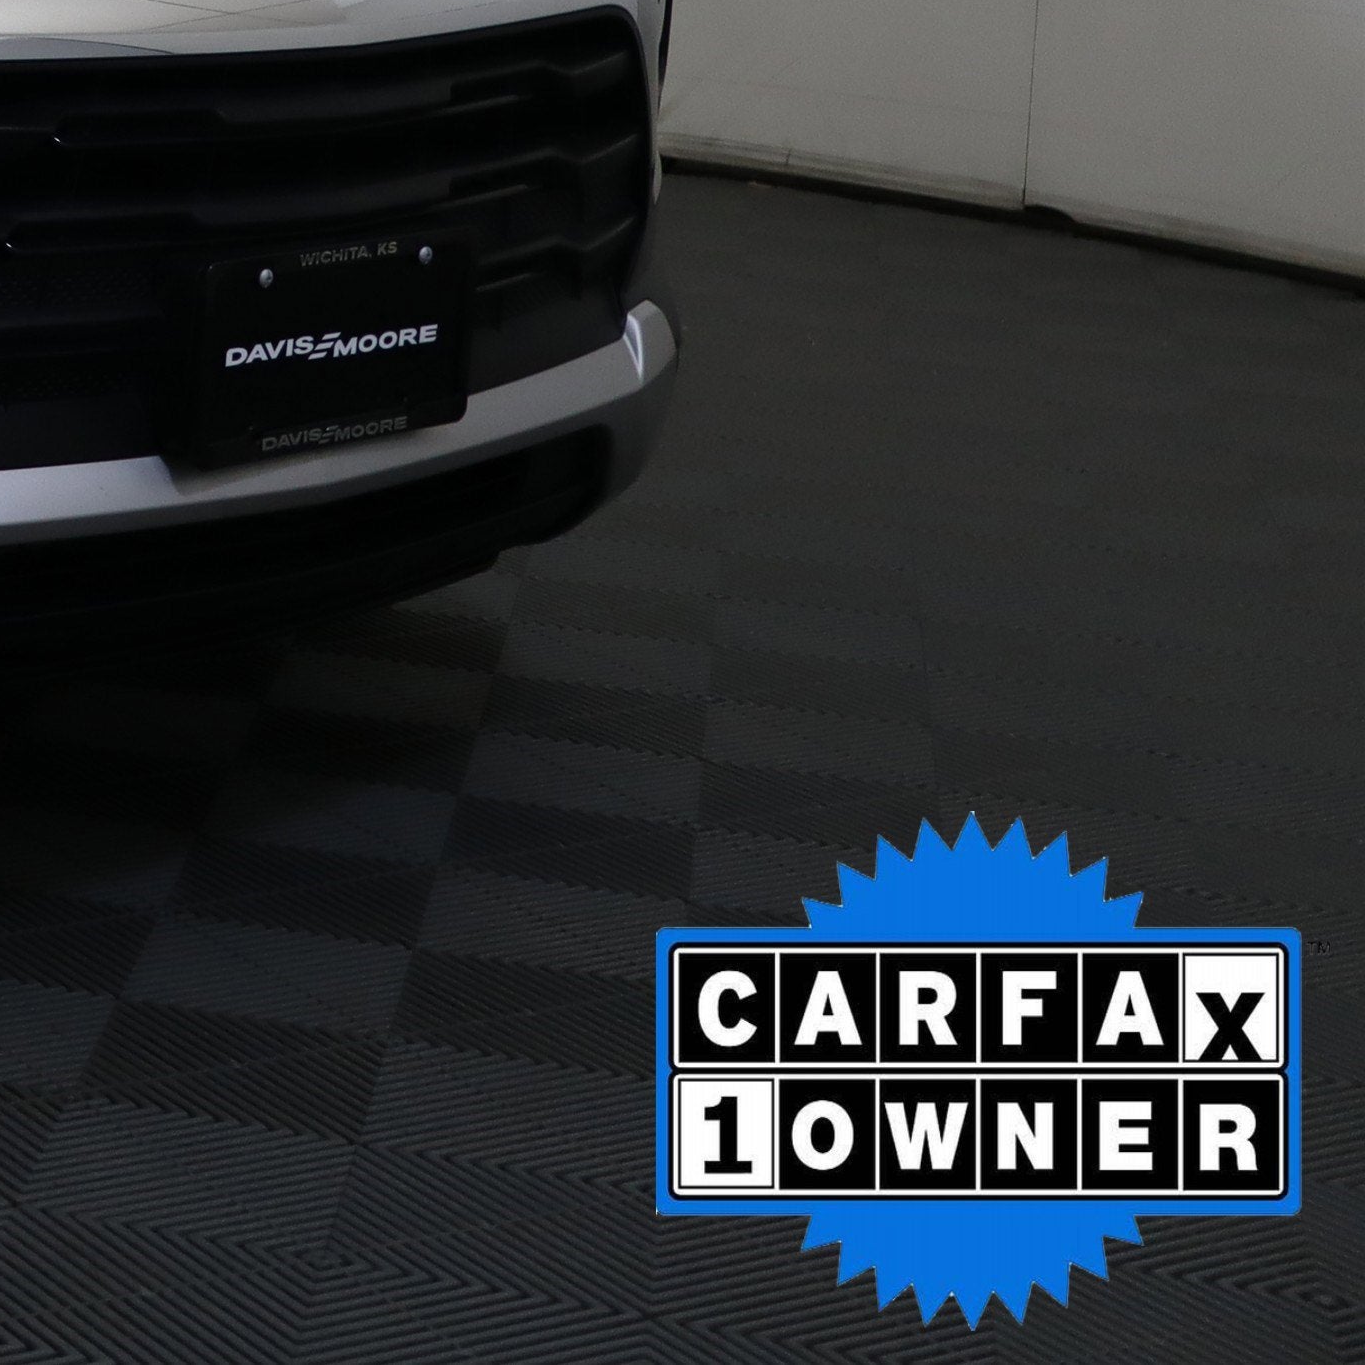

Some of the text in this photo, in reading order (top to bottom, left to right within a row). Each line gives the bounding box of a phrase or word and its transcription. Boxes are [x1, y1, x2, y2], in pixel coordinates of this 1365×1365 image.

[300, 241, 398, 267] WICHITA, KS
[225, 324, 438, 367] DAVIS MOORE
[261, 416, 407, 451] DAVIS MOORE
